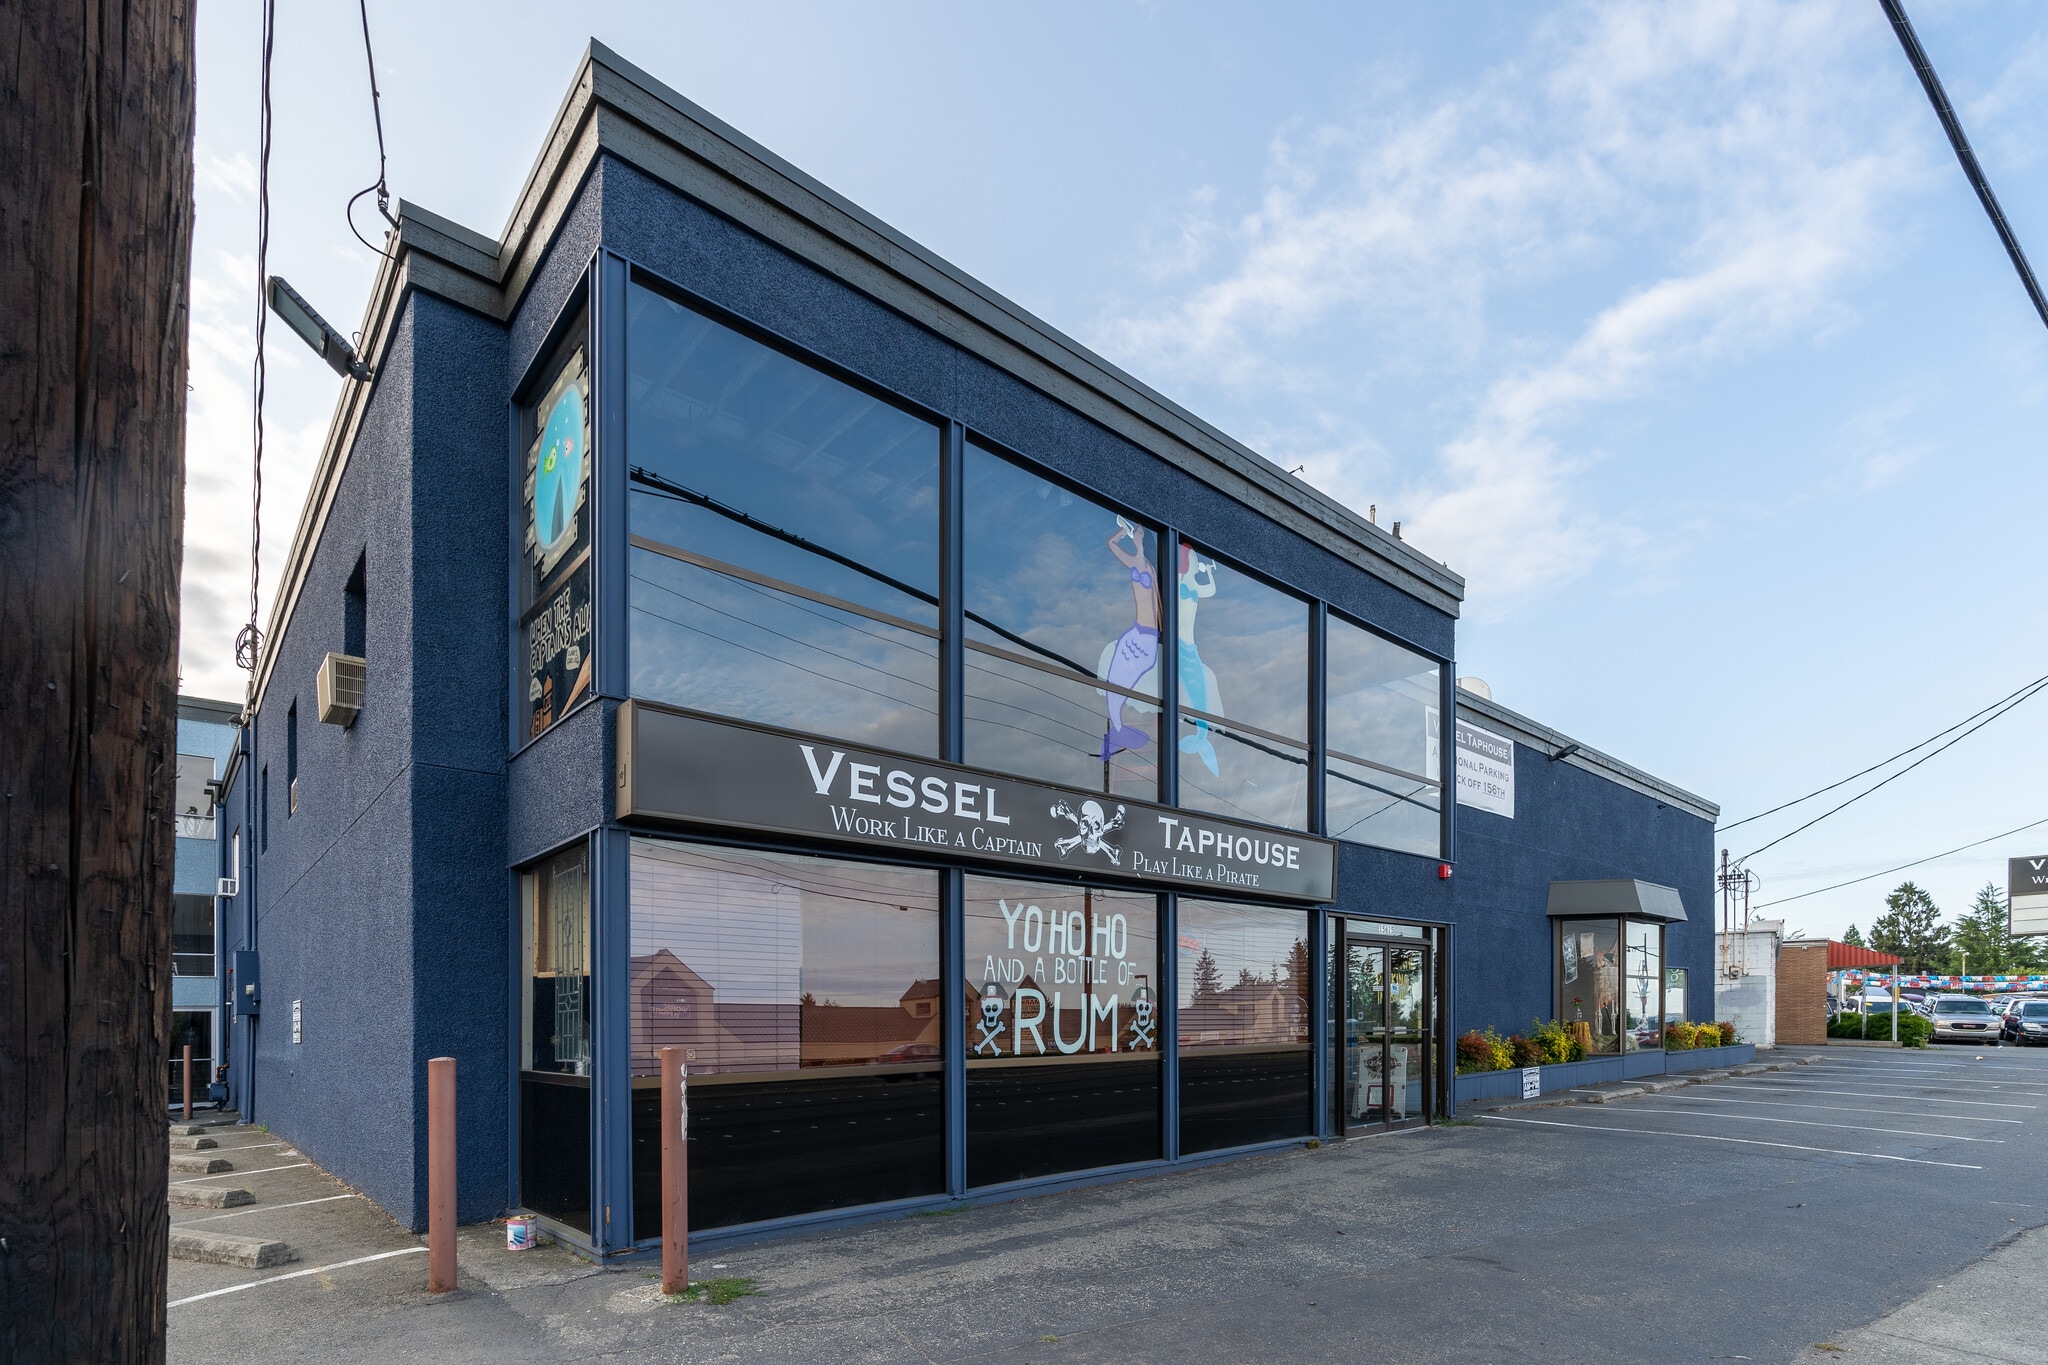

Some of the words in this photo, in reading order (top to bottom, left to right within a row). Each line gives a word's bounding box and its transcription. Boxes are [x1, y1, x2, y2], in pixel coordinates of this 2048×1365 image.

[530, 608, 552, 649] WHEN
[554, 586, 570, 629] THE
[530, 617, 571, 676] CAPTAINS
[1466, 732, 1509, 760] TAPHOUSE
[1456, 774, 1467, 785] CK
[1468, 778, 1481, 790] OFF
[1483, 781, 1506, 798] 156TH
[1479, 762, 1510, 783] PARKING
[799, 744, 1011, 826] VESSEL
[1158, 815, 1300, 870] TAPHOUSE
[830, 805, 897, 838] WORK
[902, 816, 948, 846] LIKE
[954, 832, 966, 848] A
[971, 827, 1042, 858] CAPTAIN
[1132, 851, 1168, 875] PLAY
[1172, 857, 1202, 880] LIKE
[1205, 868, 1214, 881] A
[1216, 863, 1260, 887] PIRATE
[2029, 858, 2048, 870] V
[984, 955, 1025, 983] AND
[1034, 957, 1046, 983] A
[1054, 956, 1107, 984] BOTTLE
[1014, 988, 1119, 1055] RUM
